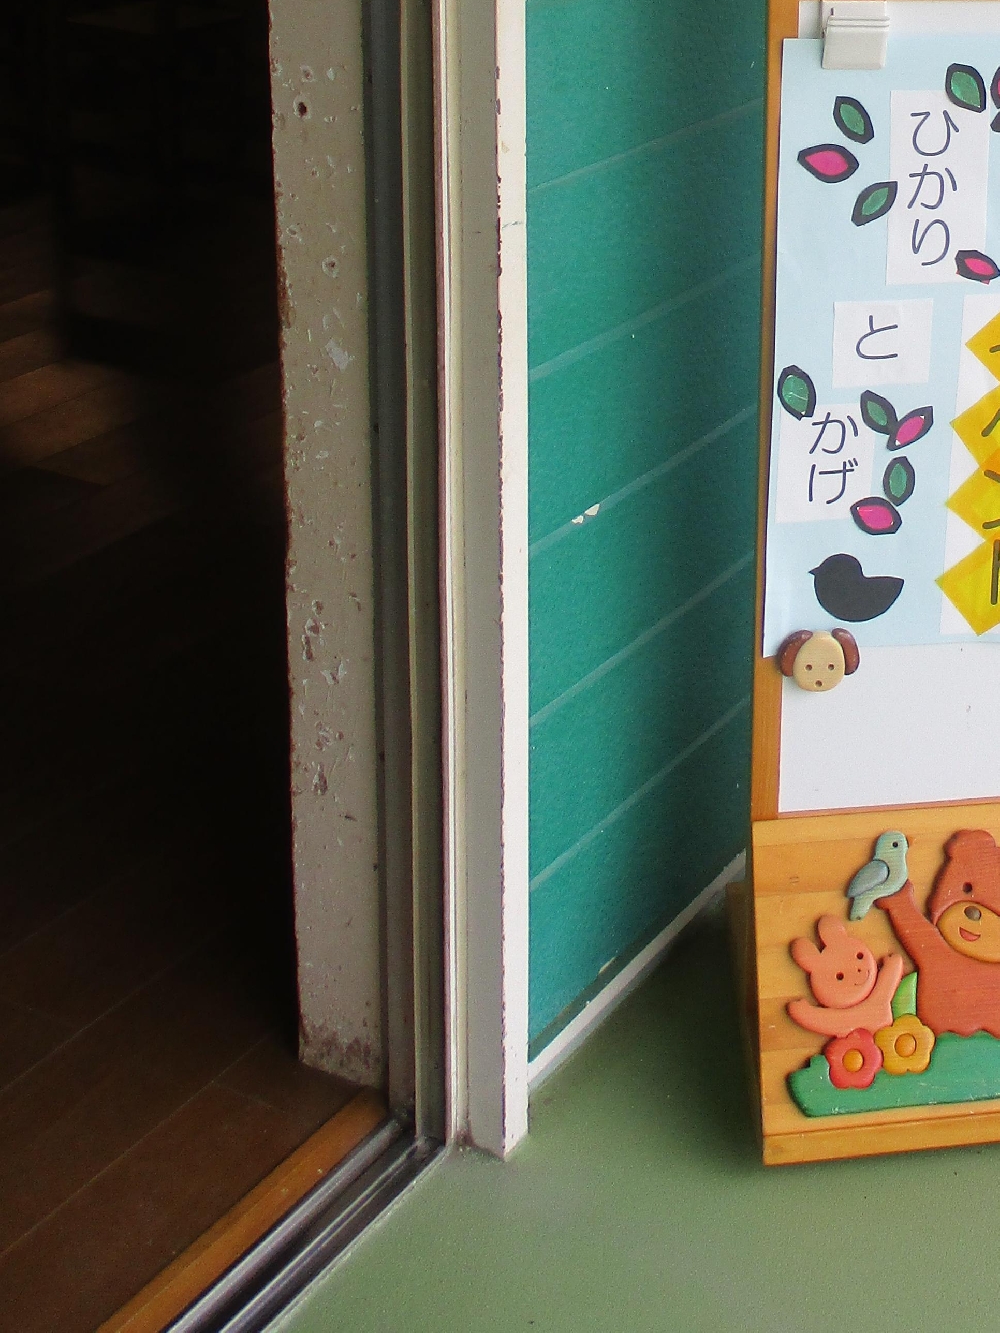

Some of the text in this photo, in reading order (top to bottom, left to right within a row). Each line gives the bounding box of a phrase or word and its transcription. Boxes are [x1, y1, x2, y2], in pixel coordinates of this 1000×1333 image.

[907, 110, 959, 266] ひかり
[856, 315, 898, 359] と
[809, 412, 858, 504] かげ
